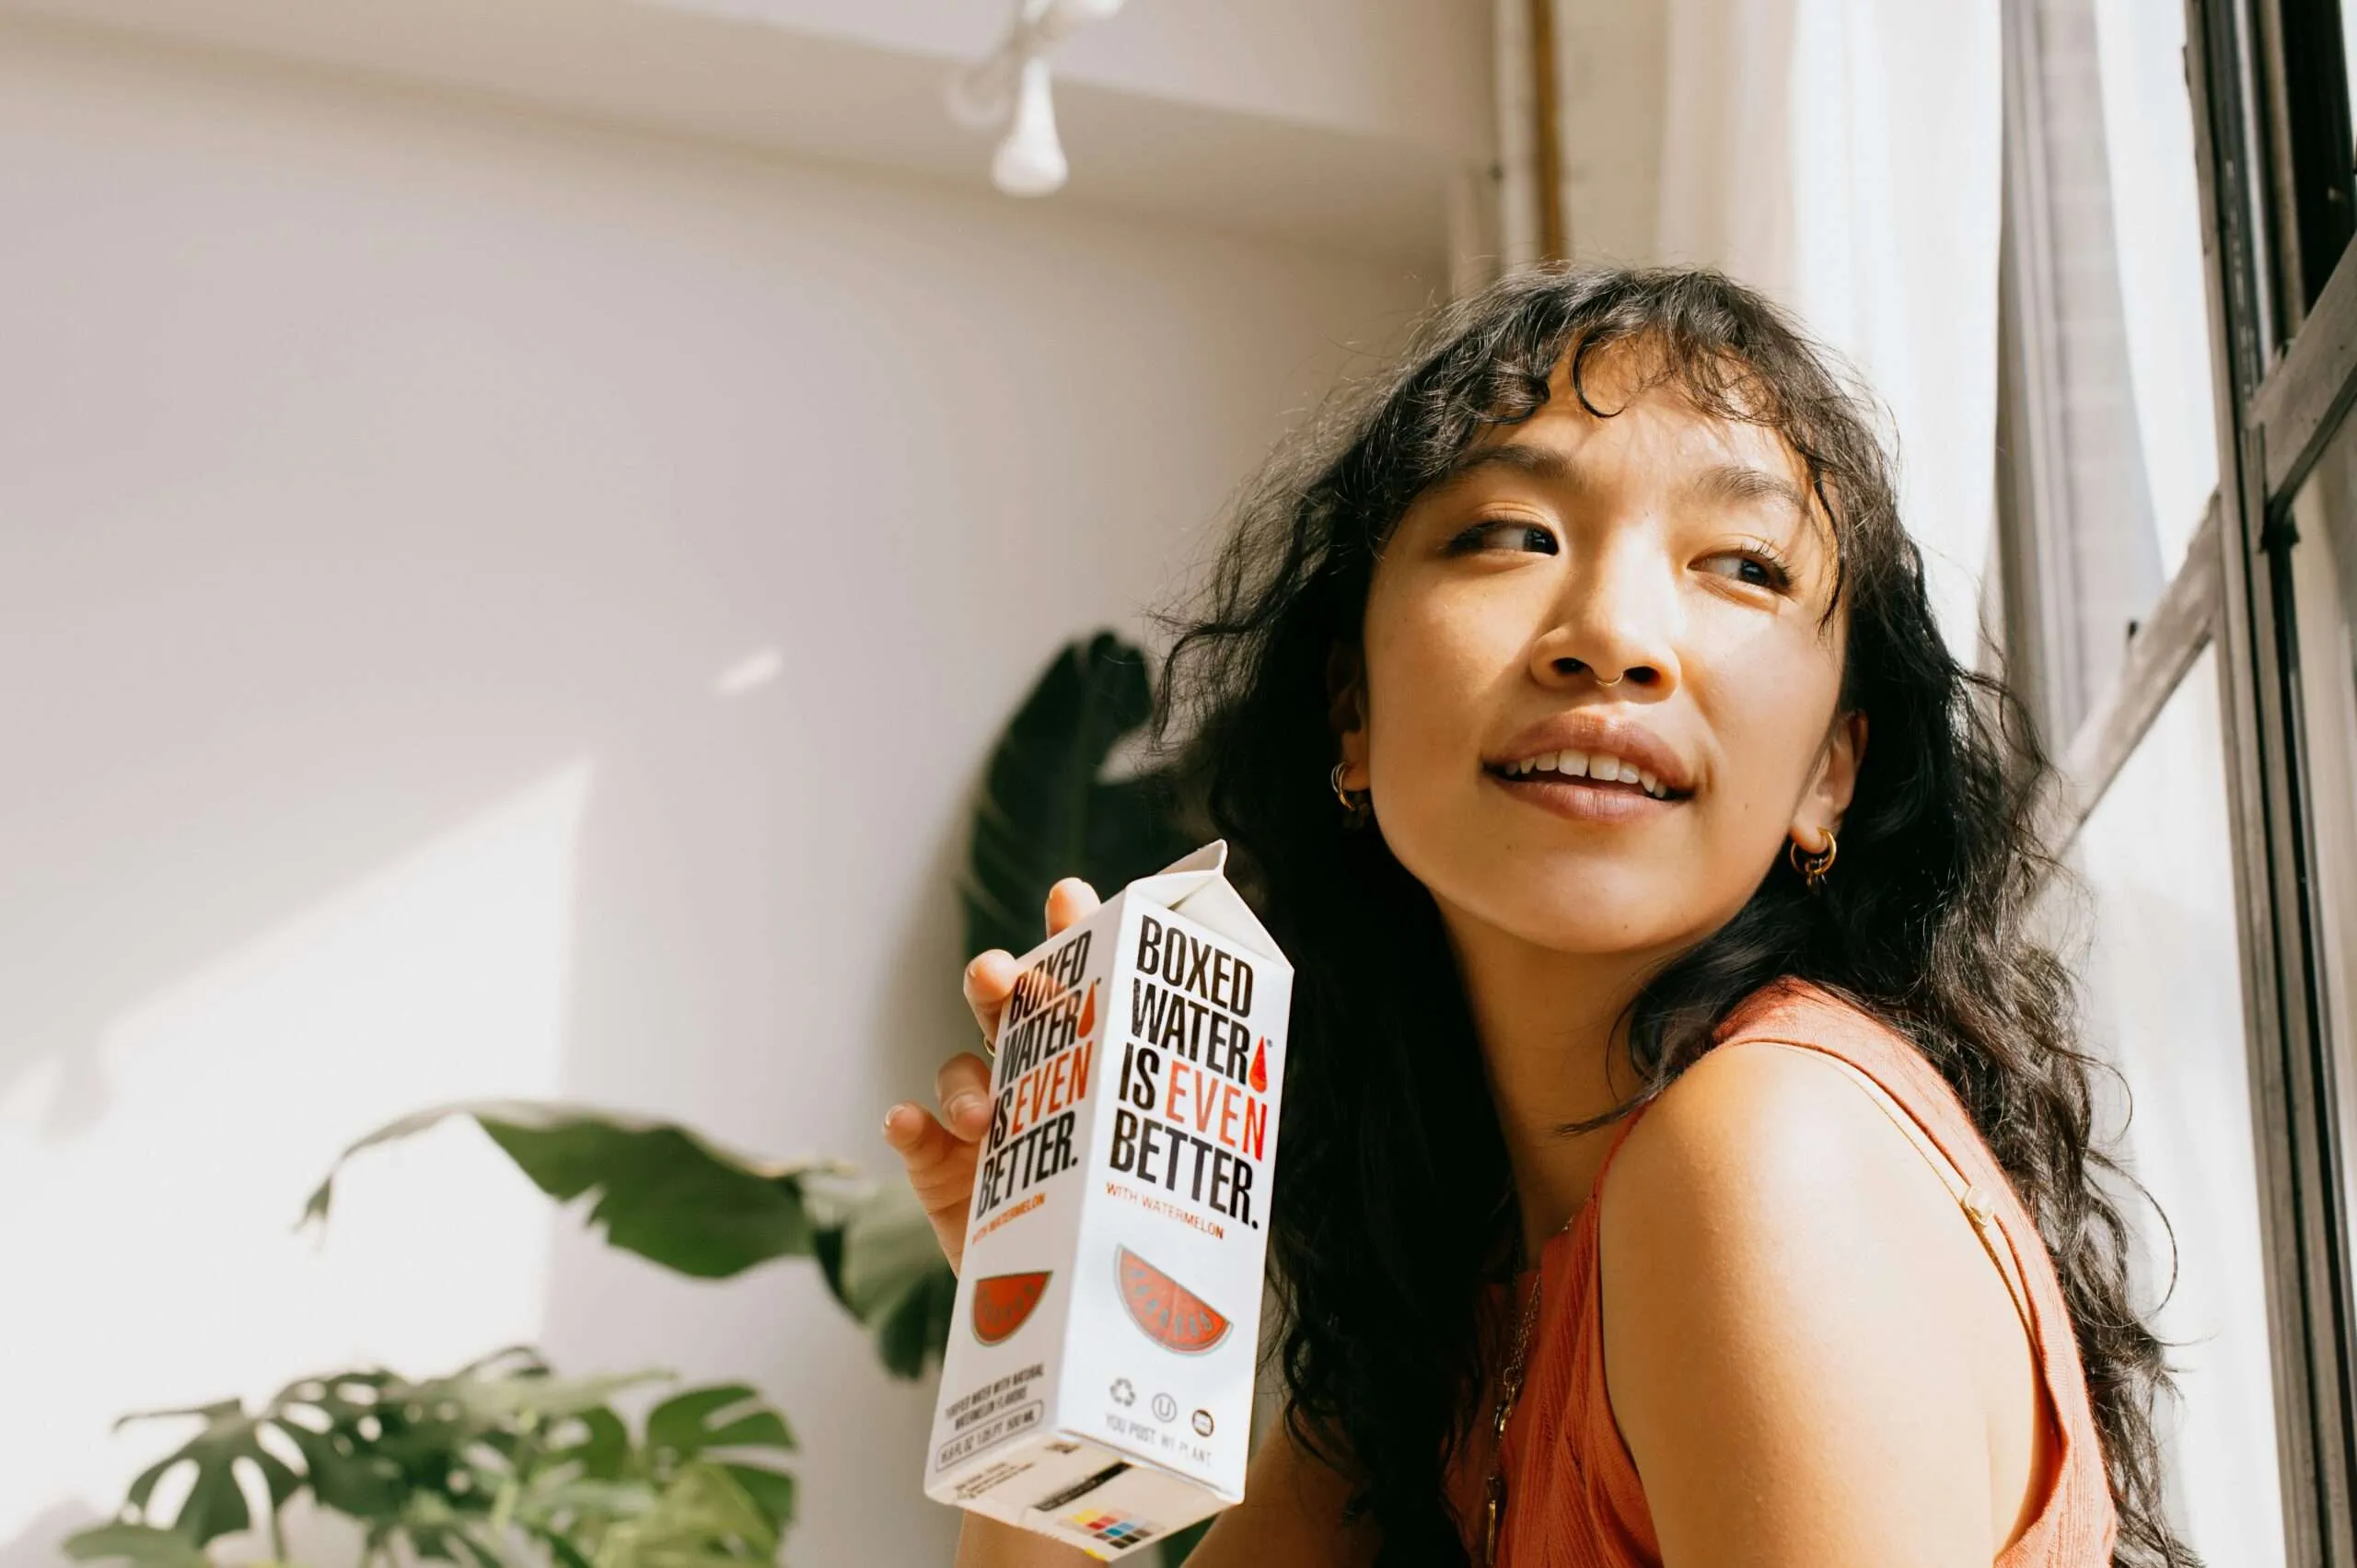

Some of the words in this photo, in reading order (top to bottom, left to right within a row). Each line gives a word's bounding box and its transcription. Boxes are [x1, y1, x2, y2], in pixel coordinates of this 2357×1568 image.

[1008, 930, 1091, 1030] BOXED
[1136, 914, 1253, 1018] BOXED
[999, 990, 1083, 1090] WATER
[1132, 978, 1250, 1086] WATER
[987, 1086, 1013, 1156] IS
[1012, 1040, 1093, 1135] EVEN
[1119, 1042, 1160, 1110] IS
[1166, 1060, 1267, 1163] EVEN
[976, 1110, 1078, 1220] BETTER.
[1106, 1182, 1137, 1201] WITH
[1143, 1194, 1224, 1239] WATERMELON
[1109, 1107, 1259, 1229] BETTER.
